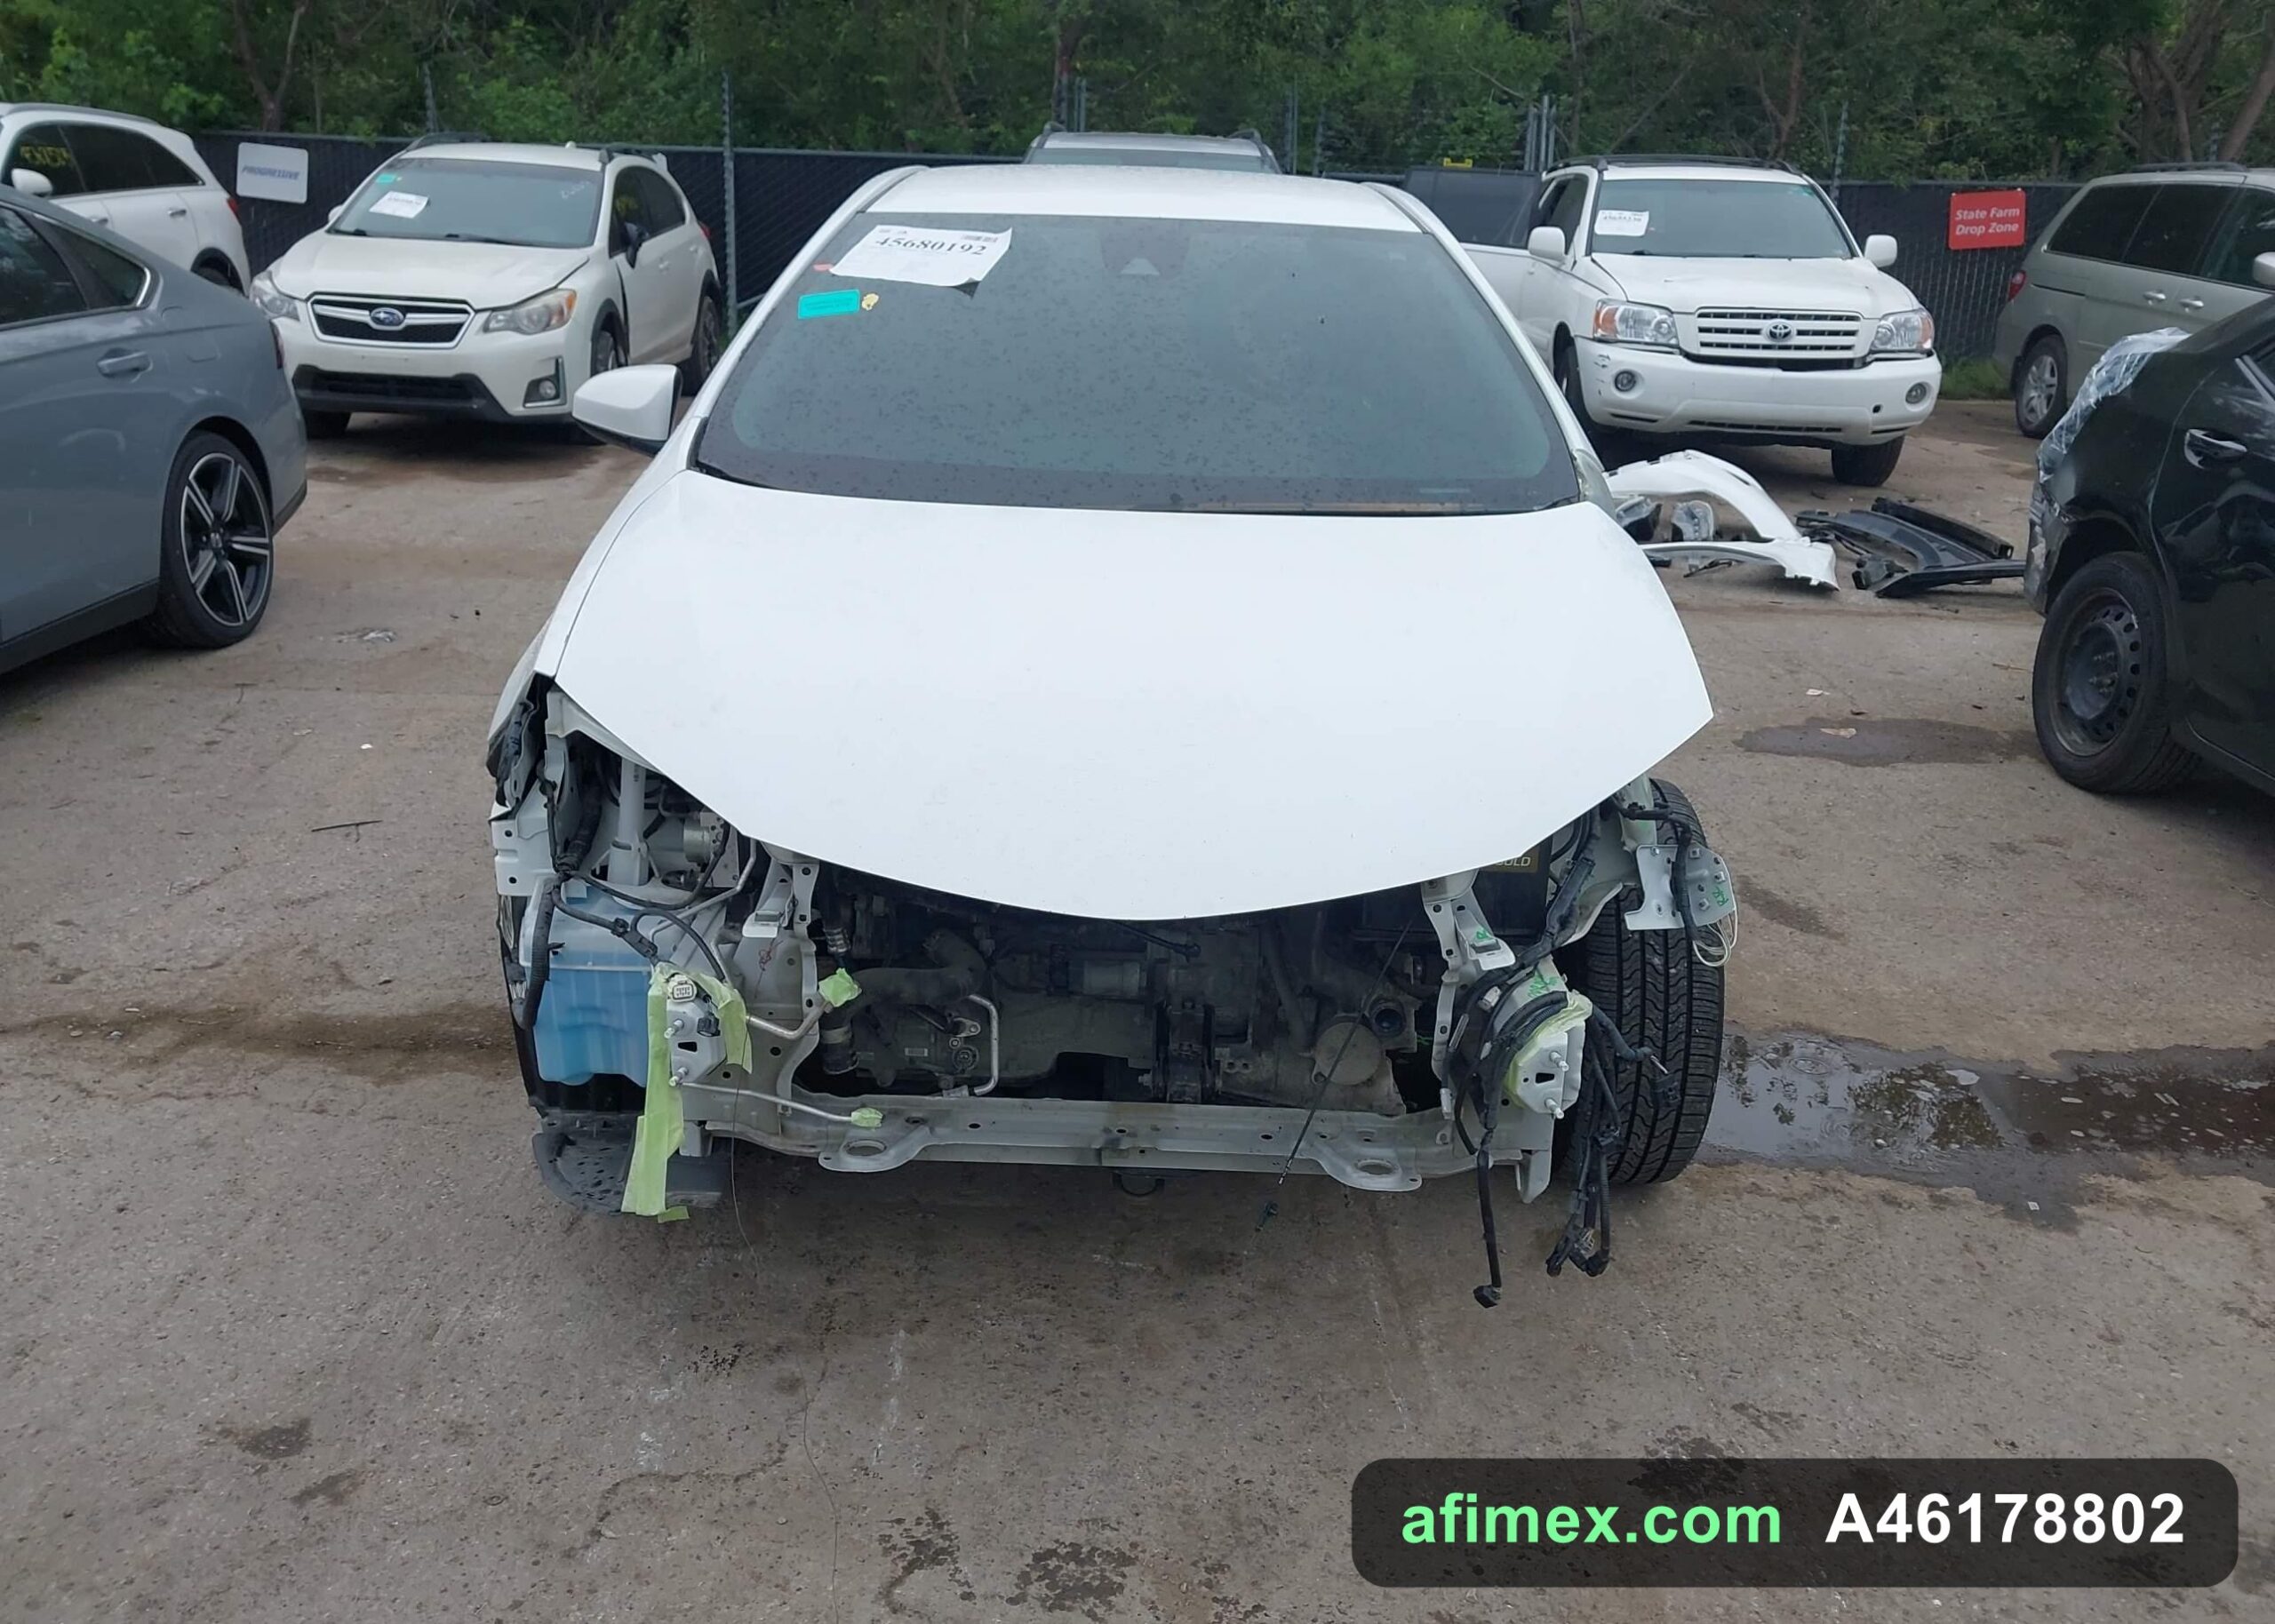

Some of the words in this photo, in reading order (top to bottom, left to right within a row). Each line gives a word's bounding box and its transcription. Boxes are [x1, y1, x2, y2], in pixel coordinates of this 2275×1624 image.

[1955, 208, 1987, 221] State
[1990, 206, 2020, 219] Farm
[1955, 223, 1985, 237] Drop
[1988, 221, 2019, 233] Zone
[874, 236, 987, 256] 45680192
